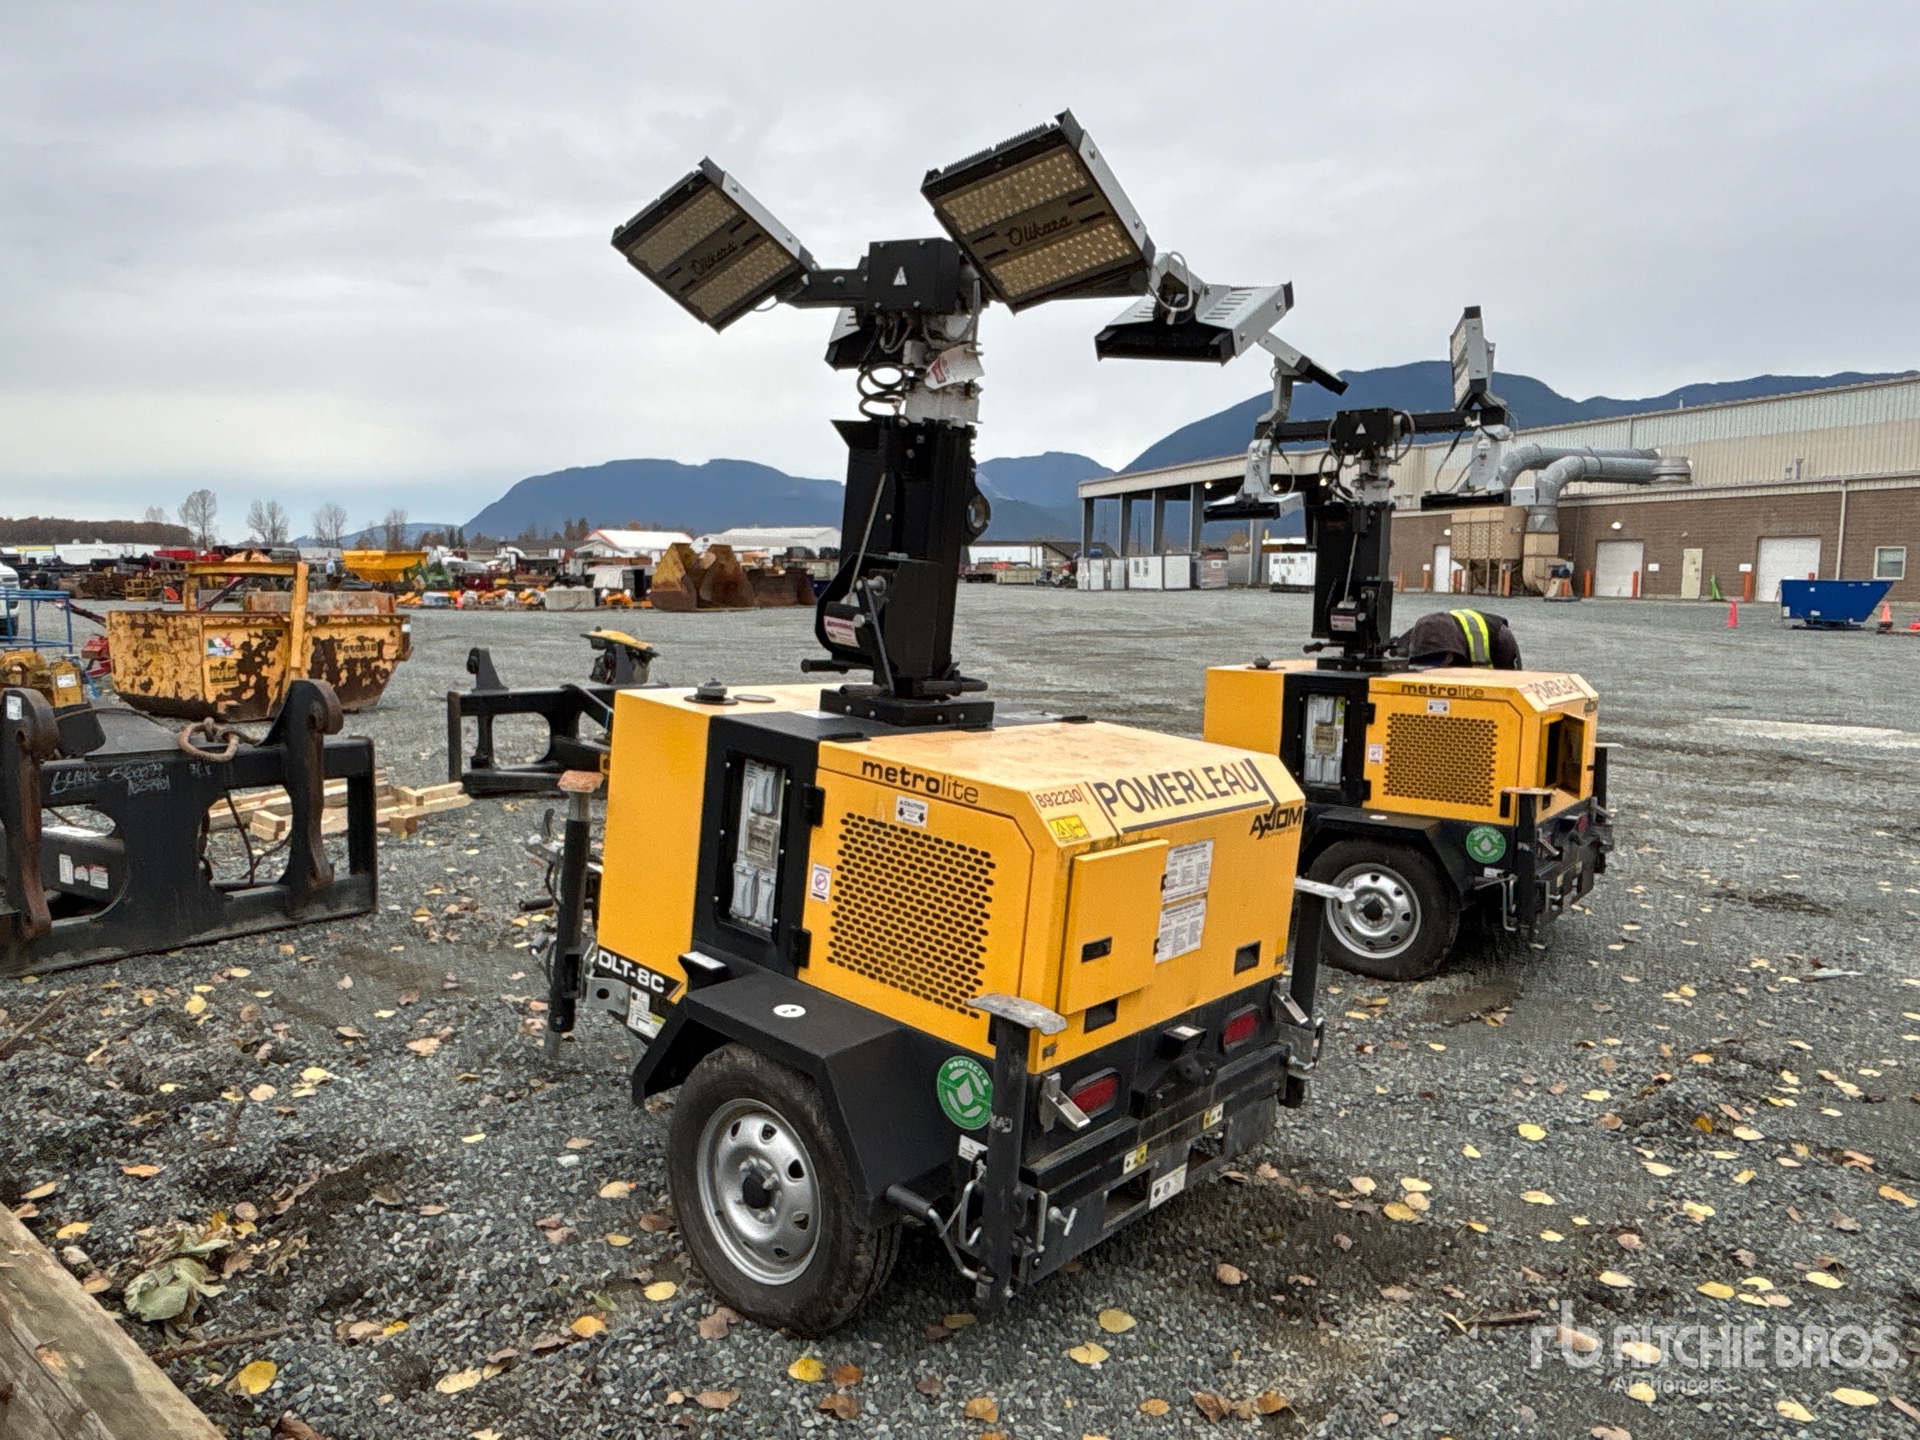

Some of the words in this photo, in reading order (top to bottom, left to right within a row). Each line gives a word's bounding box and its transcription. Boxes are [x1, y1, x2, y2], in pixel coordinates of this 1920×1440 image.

[1401, 684, 1484, 698] metrolite
[861, 760, 979, 804] metrolite
[1035, 787, 1083, 809] 892230
[1093, 758, 1259, 817] POMERLEAU
[1249, 804, 1303, 840] AXIOM
[598, 949, 665, 993] DLT-8C
